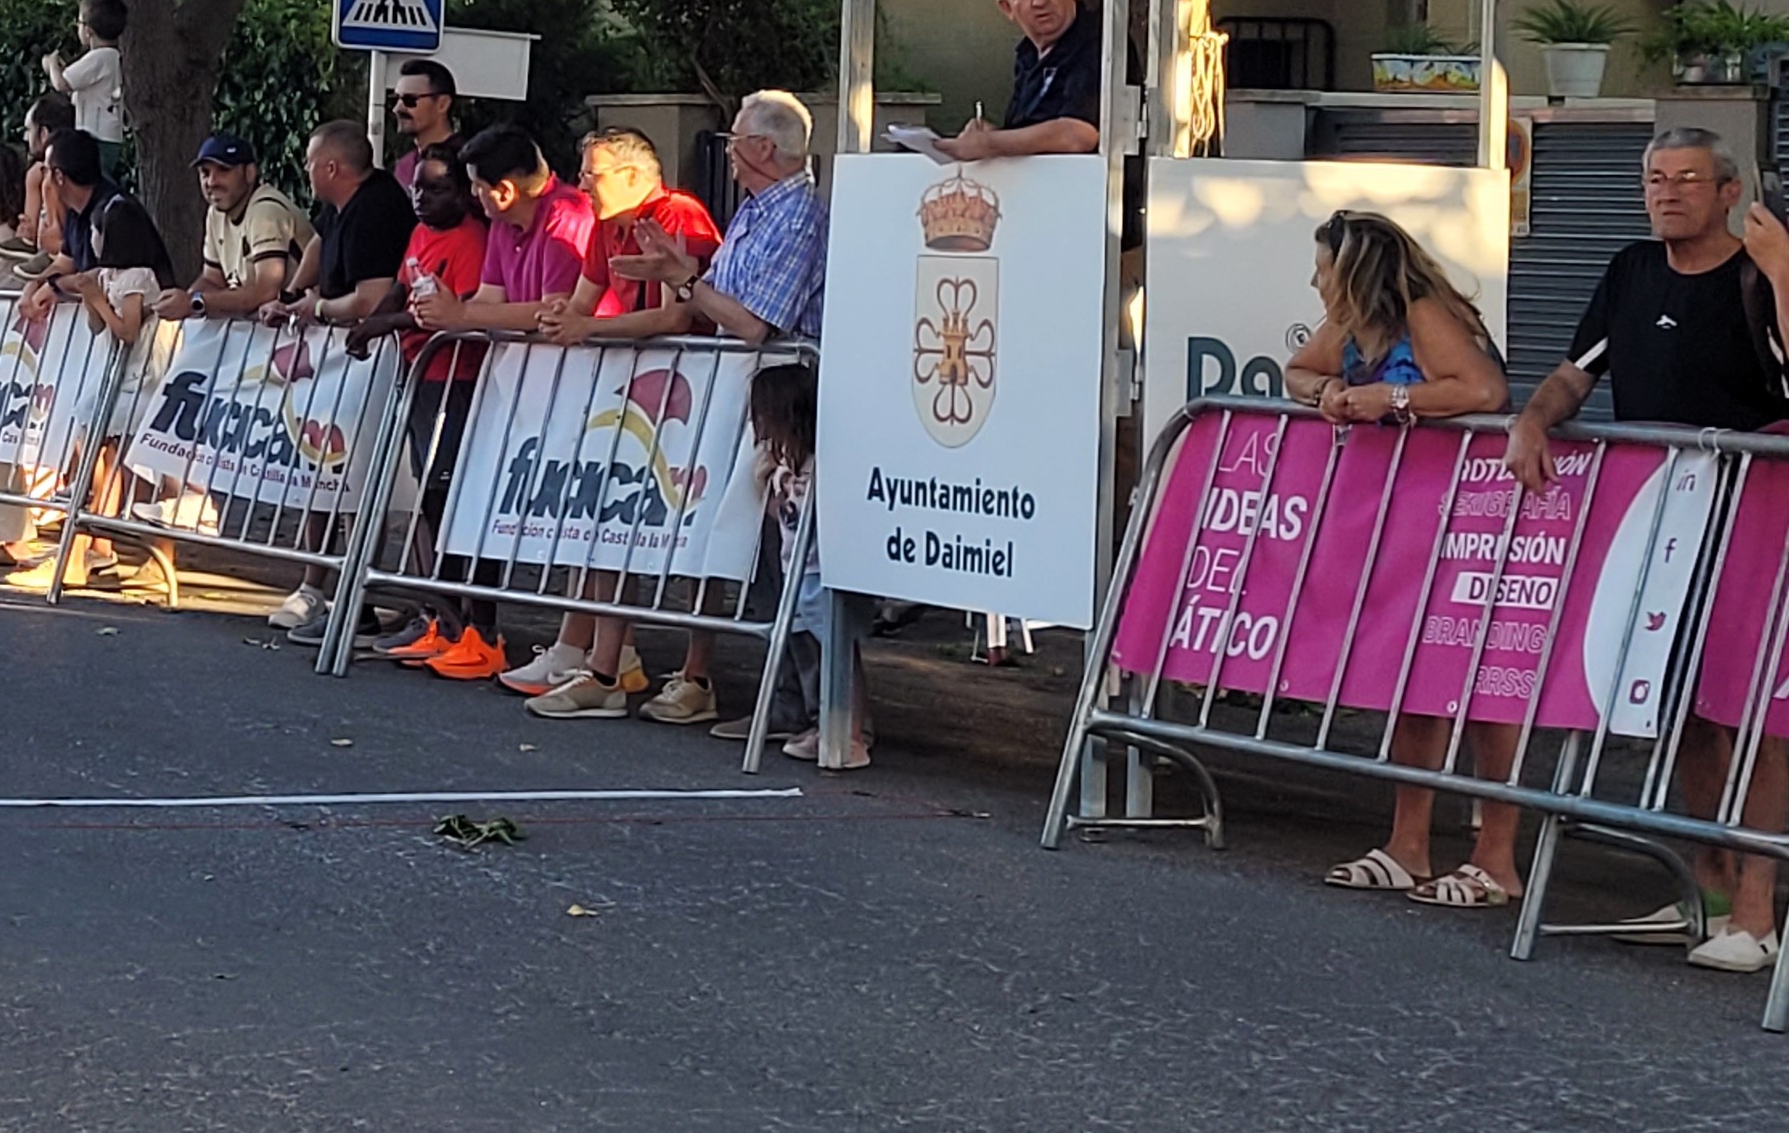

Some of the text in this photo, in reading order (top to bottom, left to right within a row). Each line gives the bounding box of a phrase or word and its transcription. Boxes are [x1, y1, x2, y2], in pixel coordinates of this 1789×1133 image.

[867, 466, 1035, 520] Ayuntamiento
[1202, 487, 1308, 541] IDEAS
[887, 526, 1014, 578] de Daimiel
[1169, 594, 1279, 660] ÁTICO
